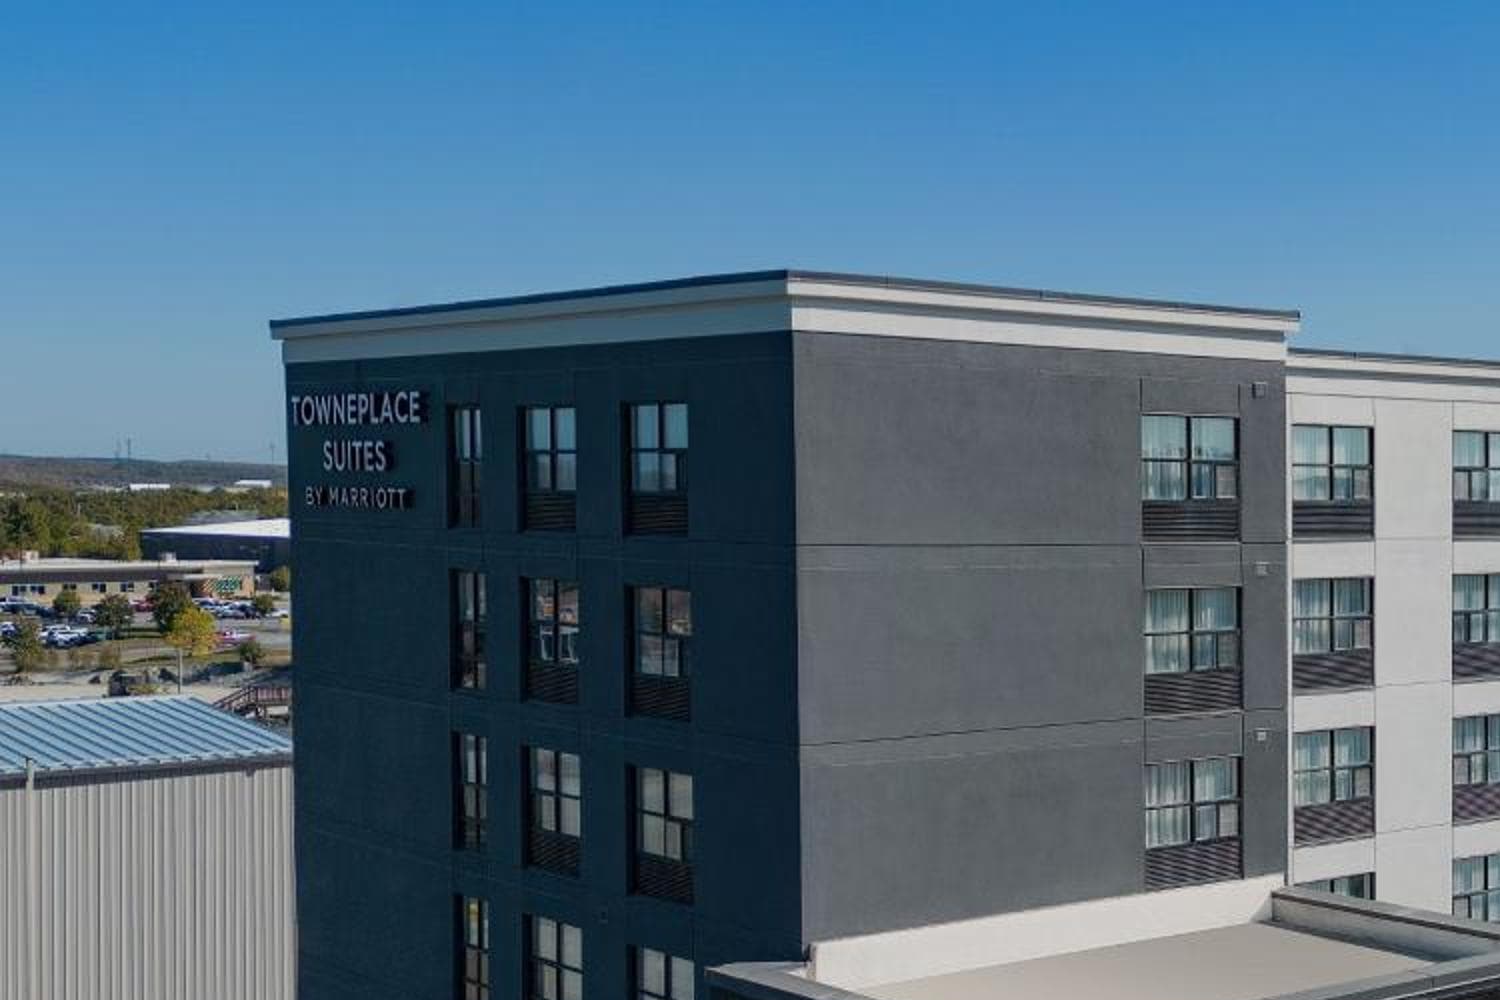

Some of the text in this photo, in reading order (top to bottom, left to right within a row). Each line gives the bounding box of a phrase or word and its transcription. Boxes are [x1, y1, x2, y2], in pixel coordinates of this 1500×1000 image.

[291, 391, 421, 425] TOWNEPLACE
[323, 440, 387, 472] SUITES
[305, 486, 407, 511] BY MARRIOTT
